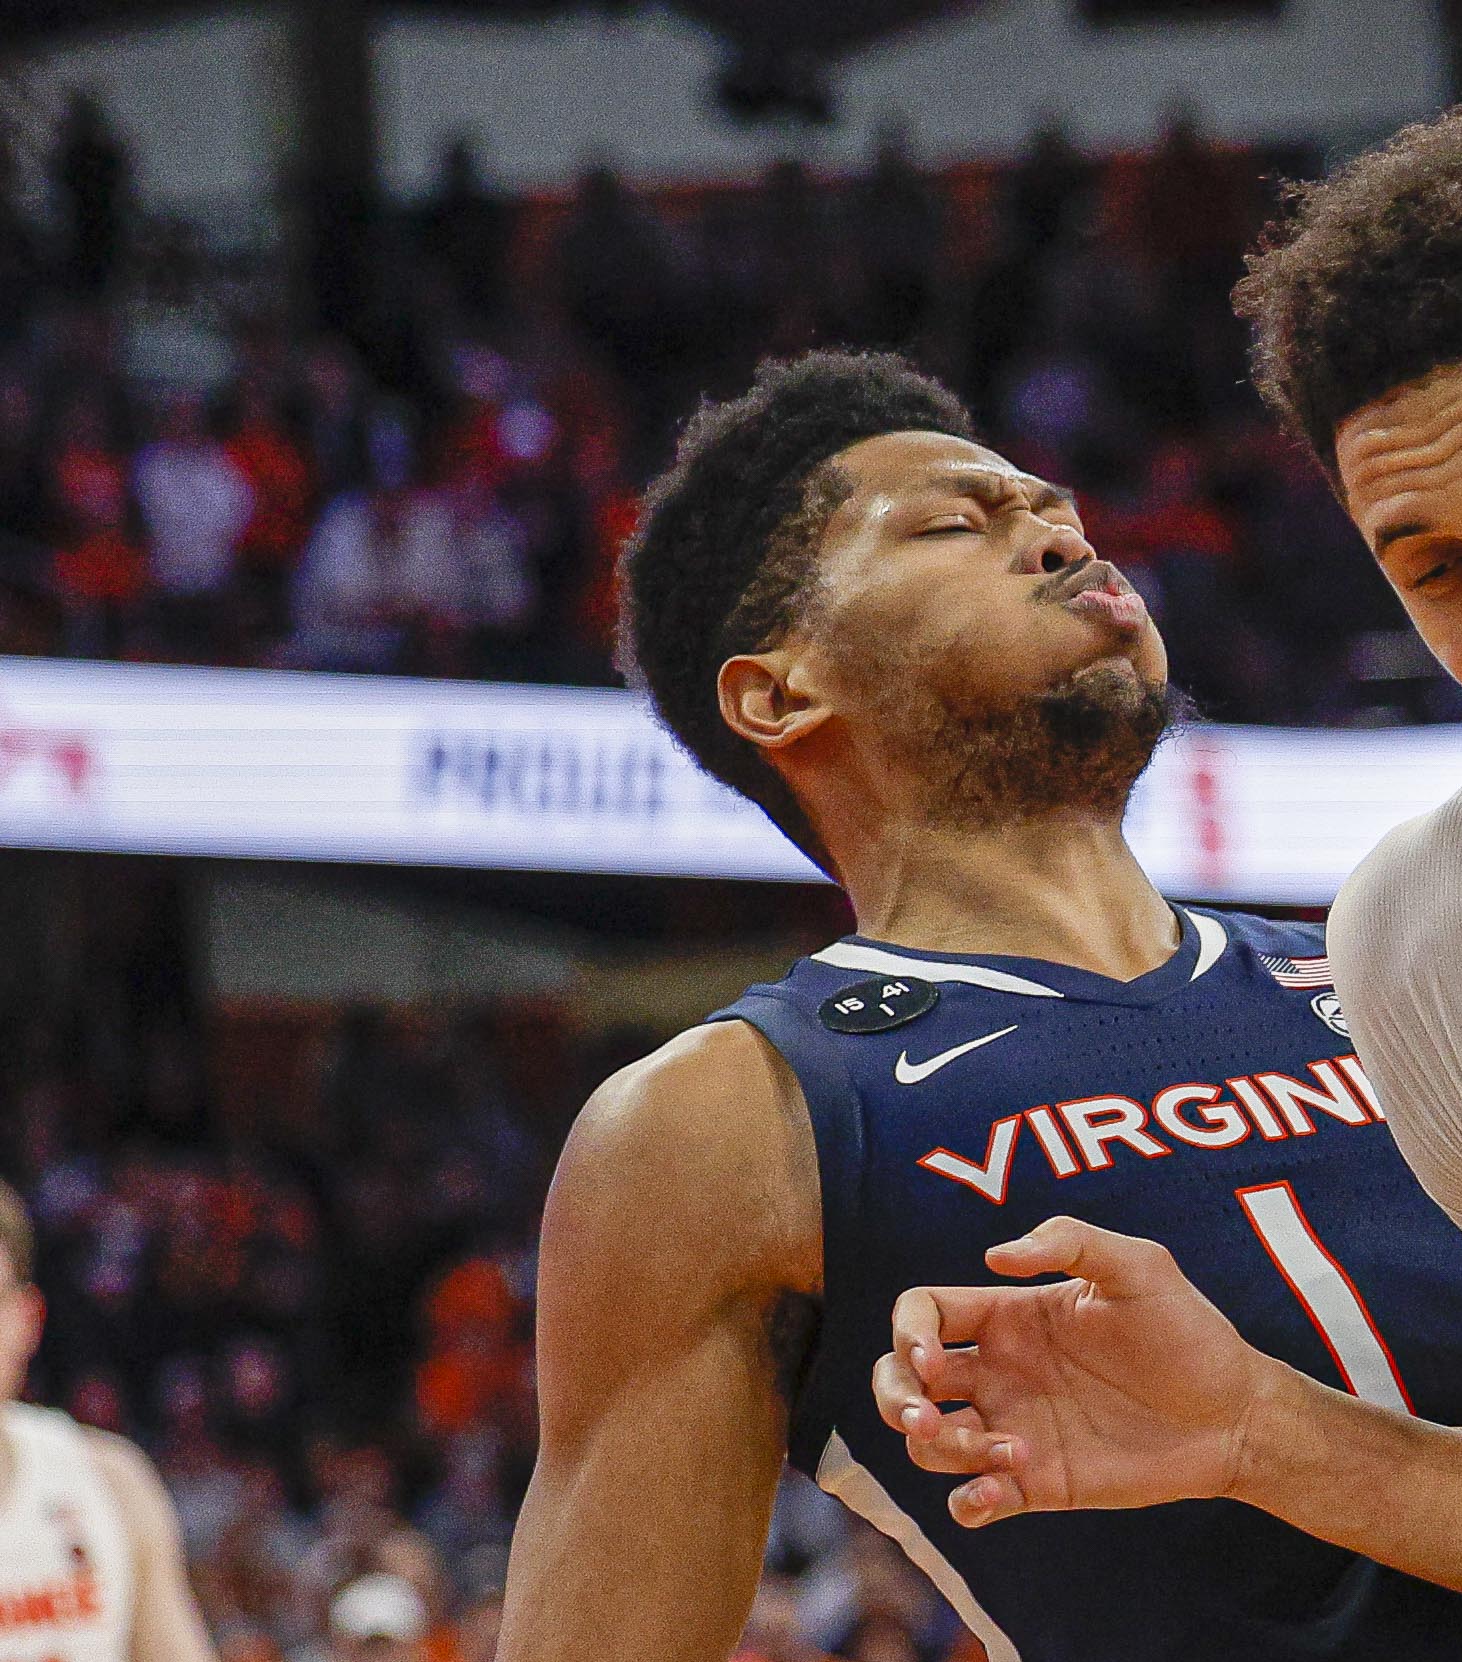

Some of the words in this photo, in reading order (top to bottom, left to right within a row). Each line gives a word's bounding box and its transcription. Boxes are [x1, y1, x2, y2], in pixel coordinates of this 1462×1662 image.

[834, 997, 866, 1015] 15
[882, 981, 911, 999] 41
[916, 1054, 1389, 1205] VIRGINI
[1233, 1179, 1417, 1420] 1
